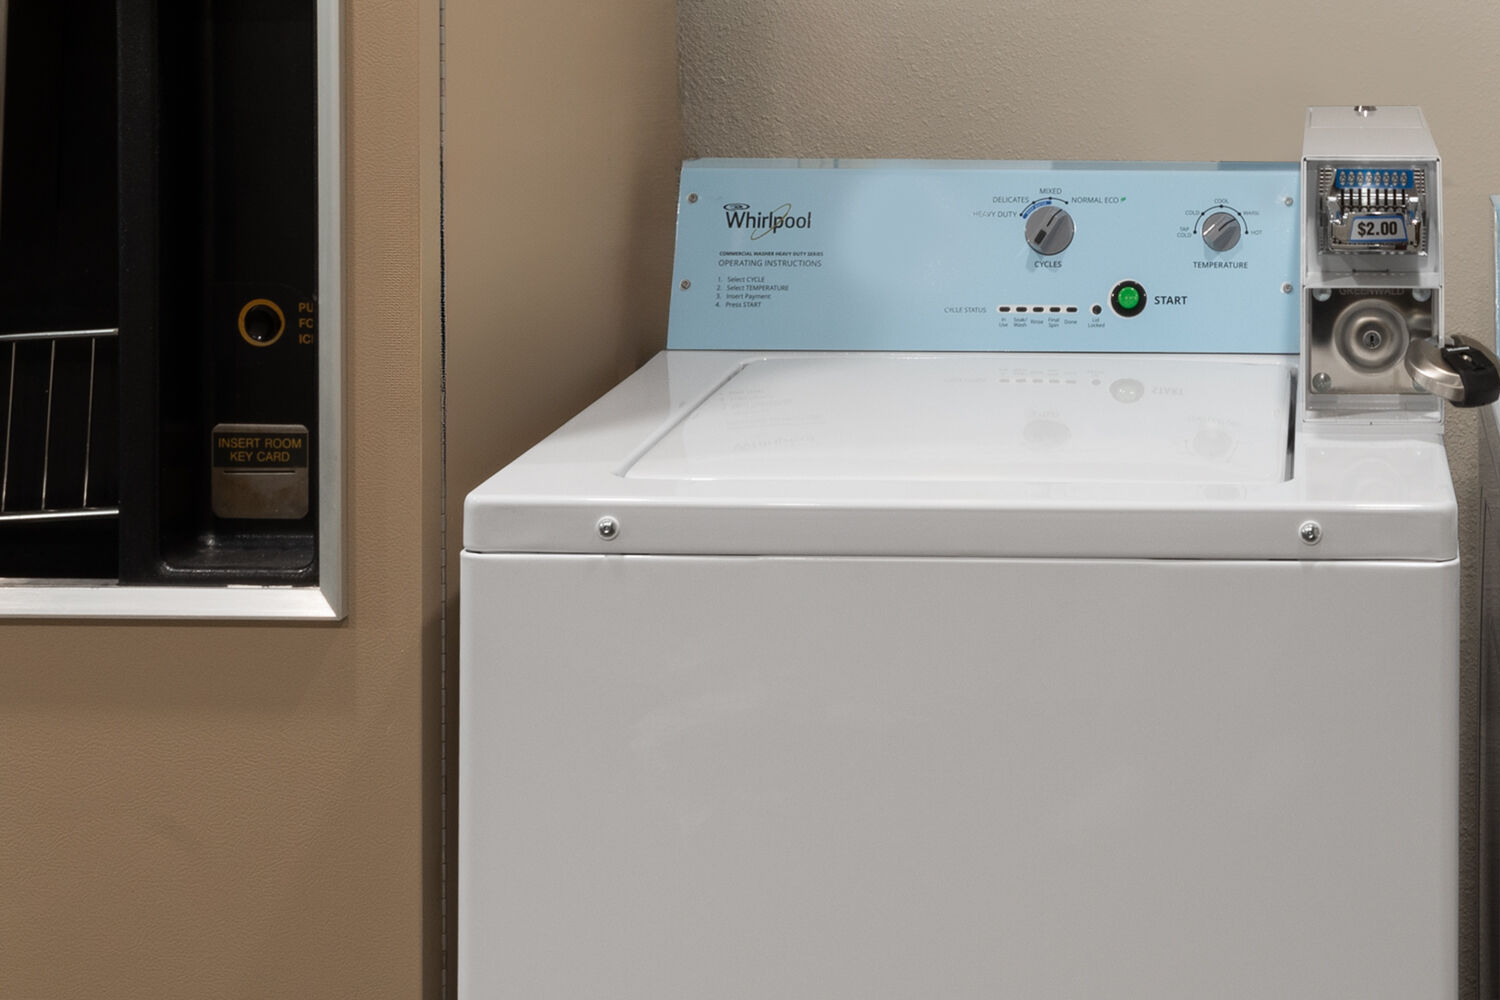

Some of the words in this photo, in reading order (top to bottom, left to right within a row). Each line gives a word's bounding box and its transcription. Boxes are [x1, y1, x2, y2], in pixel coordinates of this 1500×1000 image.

[1039, 187, 1062, 195] MIXED
[992, 196, 1030, 204] DELICATES
[1071, 196, 1101, 204] NORMAL
[1104, 196, 1119, 204] ECO
[725, 211, 811, 234] Whirlpool
[1357, 221, 1398, 237] $2.00
[718, 259, 763, 268] OPERATING
[764, 259, 822, 268] INSTRUCTIONS
[1193, 261, 1249, 269] TEMPERATURE
[1154, 296, 1188, 305] START
[298, 302, 314, 313] PU
[298, 333, 314, 345] IC
[218, 437, 261, 449] INSERT
[264, 437, 302, 449] ROOM
[229, 451, 253, 462] KEY
[256, 451, 290, 462] CARD
